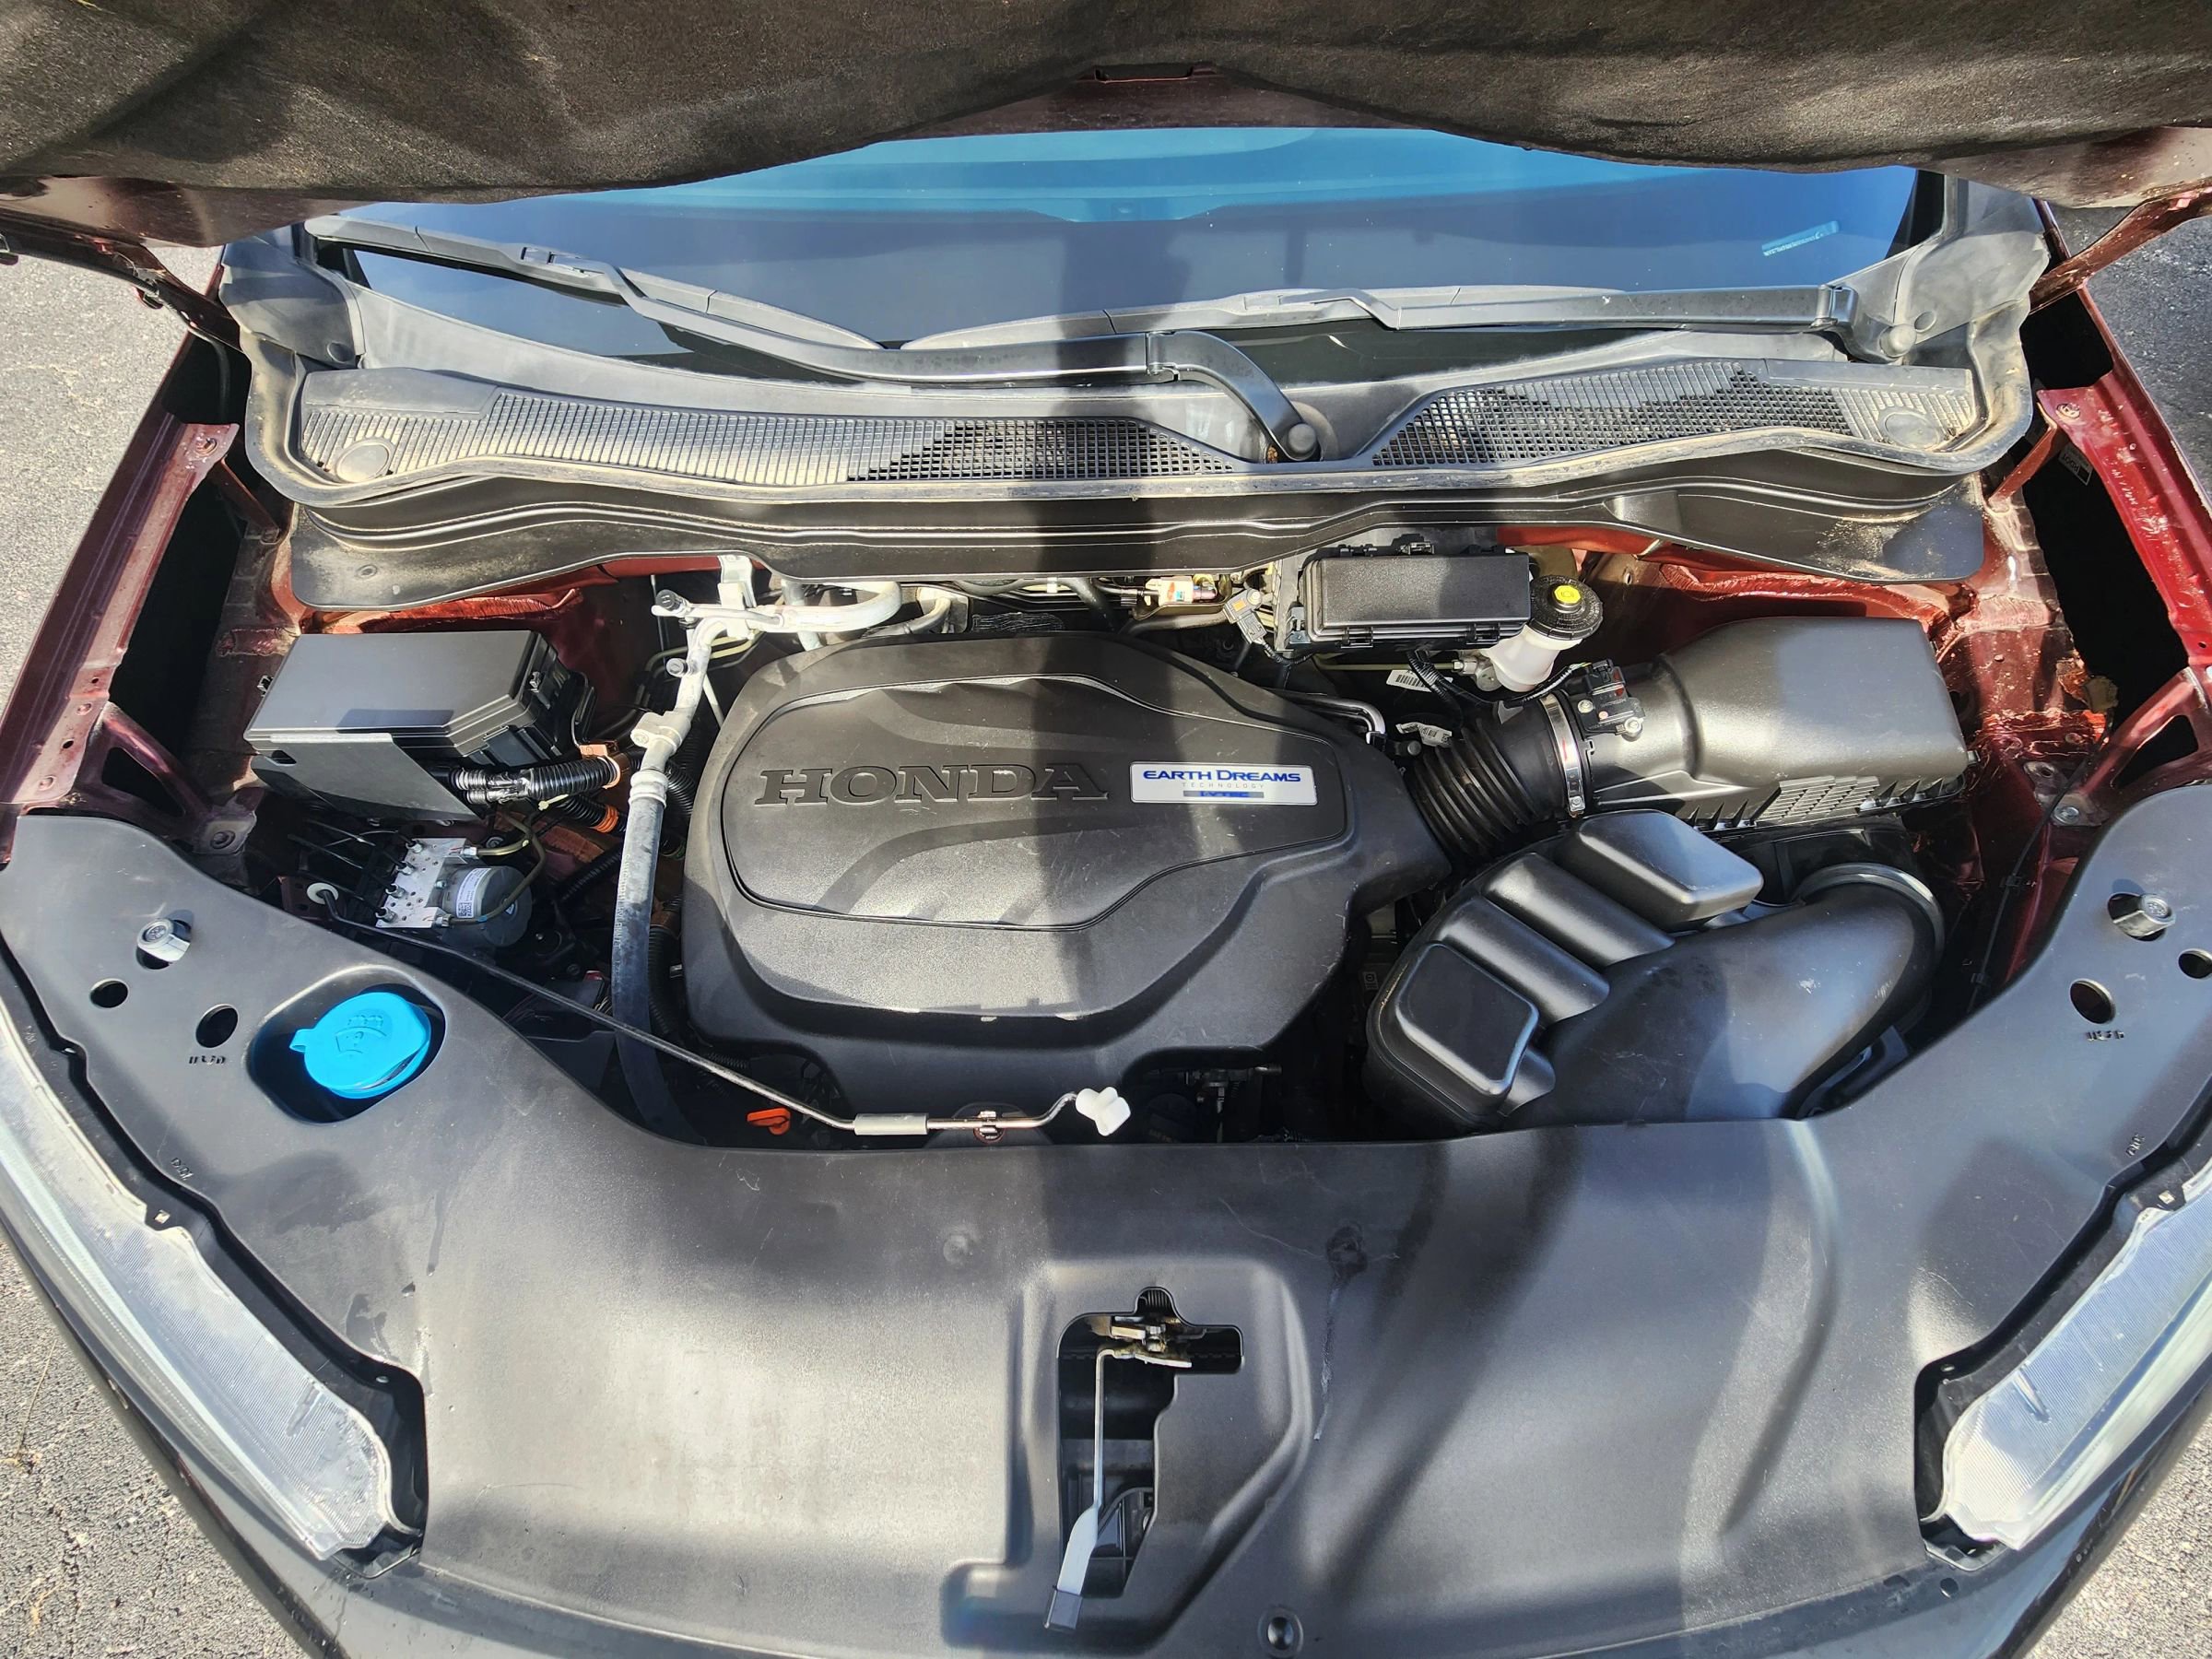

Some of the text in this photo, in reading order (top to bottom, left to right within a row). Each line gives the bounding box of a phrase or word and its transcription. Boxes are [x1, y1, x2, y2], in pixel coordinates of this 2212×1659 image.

[754, 763, 1108, 806] HONDA
[1143, 770, 1301, 782] EARTH DREAMS
